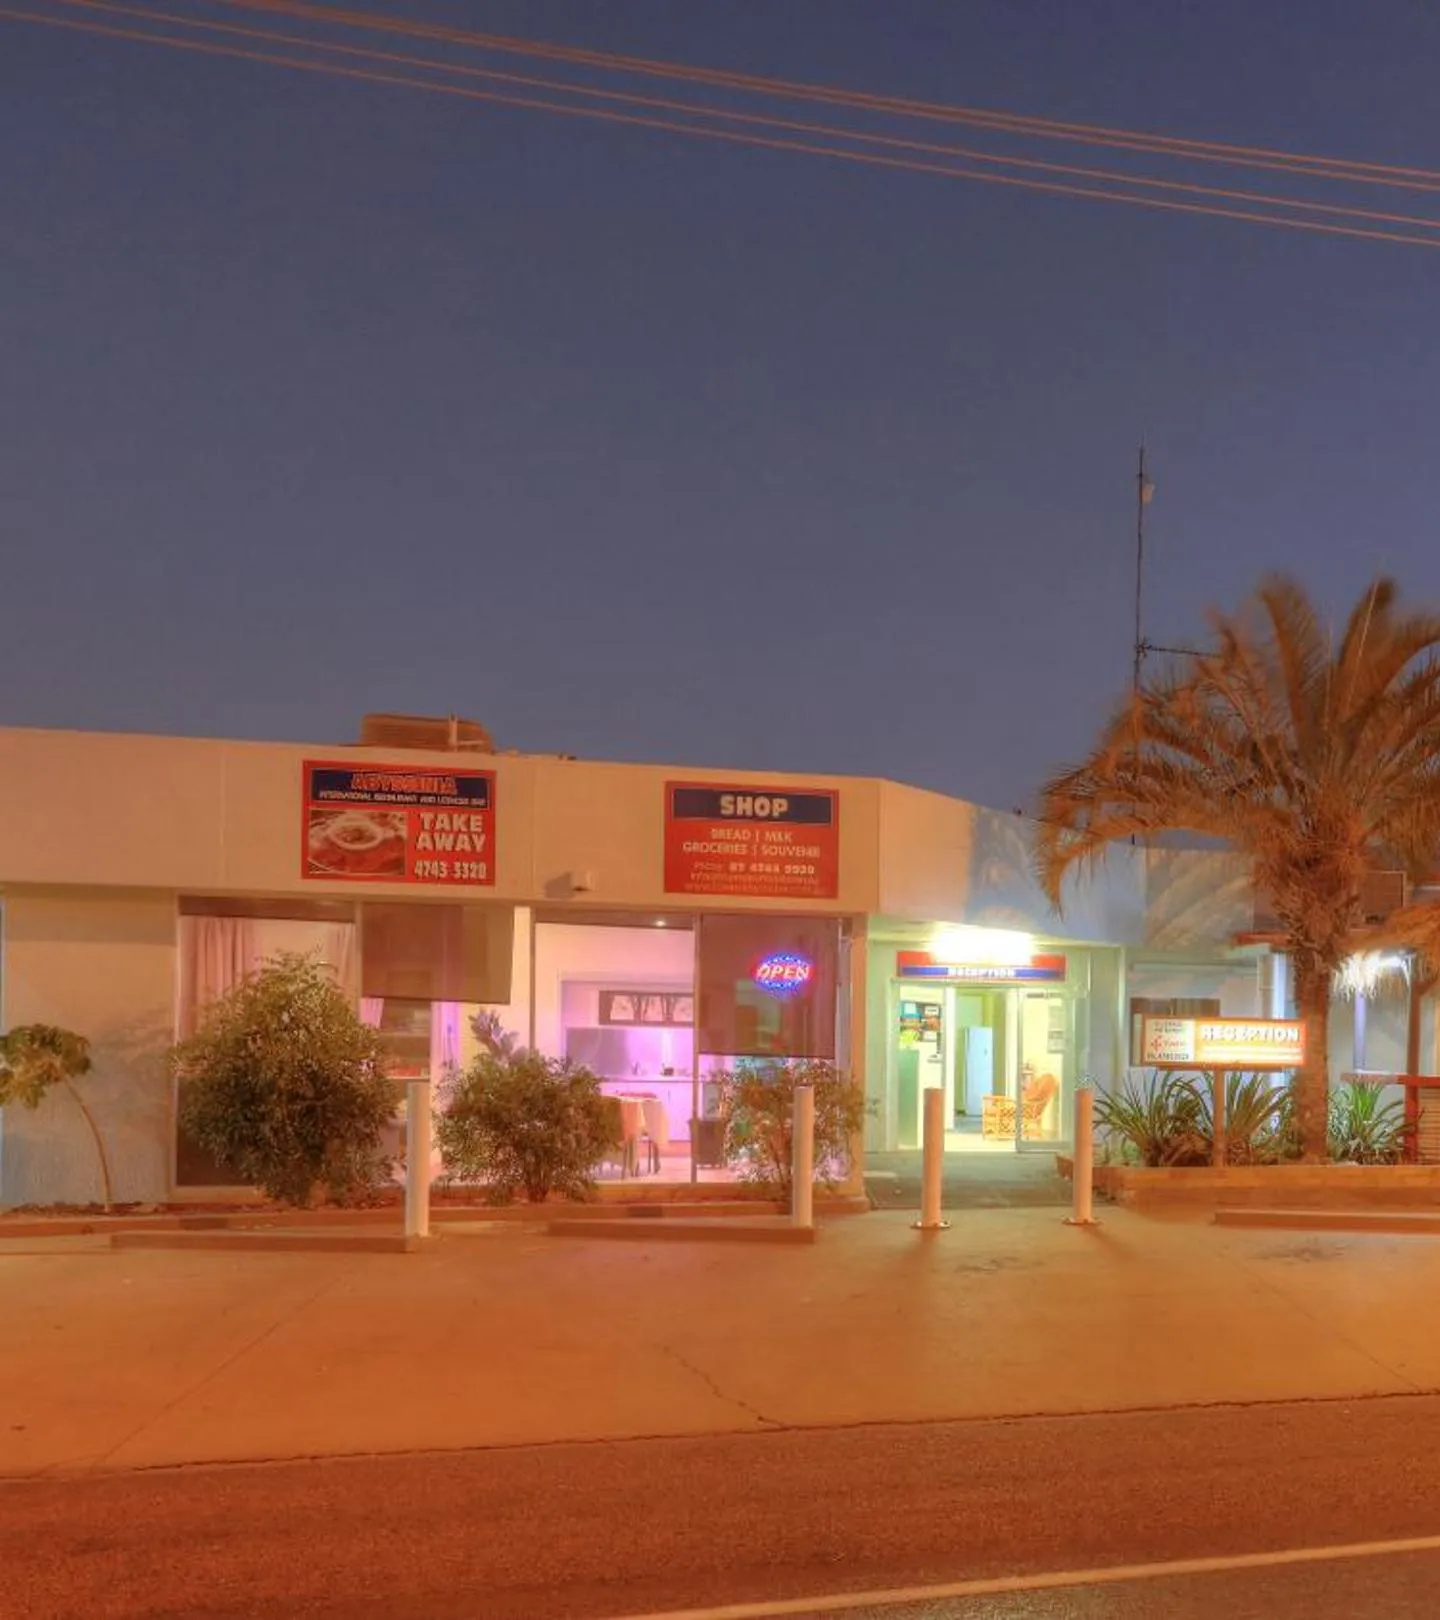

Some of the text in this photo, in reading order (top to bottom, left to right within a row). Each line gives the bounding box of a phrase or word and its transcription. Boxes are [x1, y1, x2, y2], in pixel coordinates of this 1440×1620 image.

[720, 794, 789, 817] SHOP
[420, 812, 483, 832] TAKE
[416, 831, 486, 853] AWAY
[711, 828, 793, 843] BREAD MILK
[682, 842, 749, 856] GROCERIES
[756, 964, 810, 981] OPEN
[1201, 1026, 1300, 1042] RECEPTION
